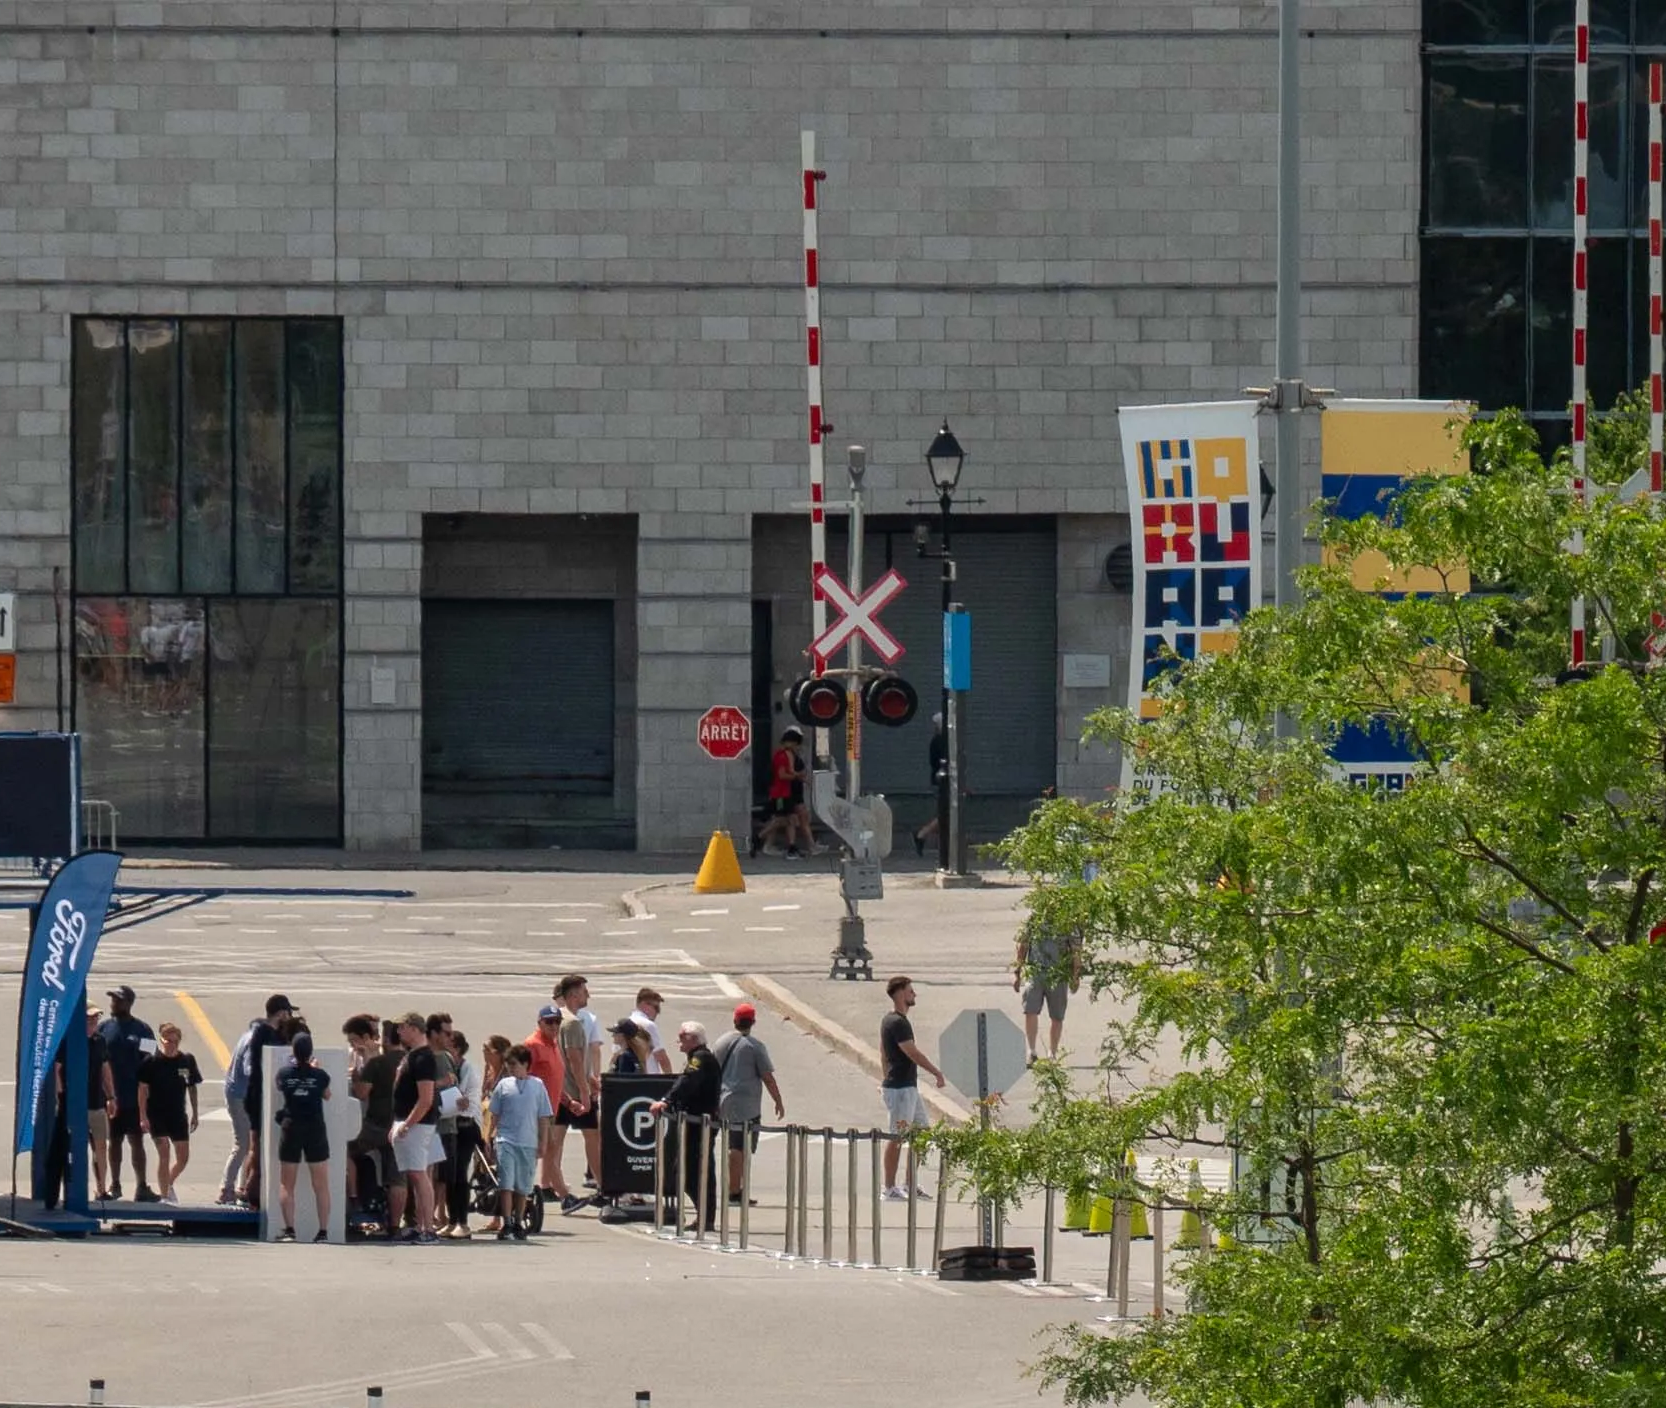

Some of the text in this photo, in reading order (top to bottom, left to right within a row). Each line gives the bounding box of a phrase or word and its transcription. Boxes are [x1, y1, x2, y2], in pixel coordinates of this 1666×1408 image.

[41, 899, 87, 992] Ford
[37, 998, 48, 1018] des
[635, 1111, 655, 1138] P
